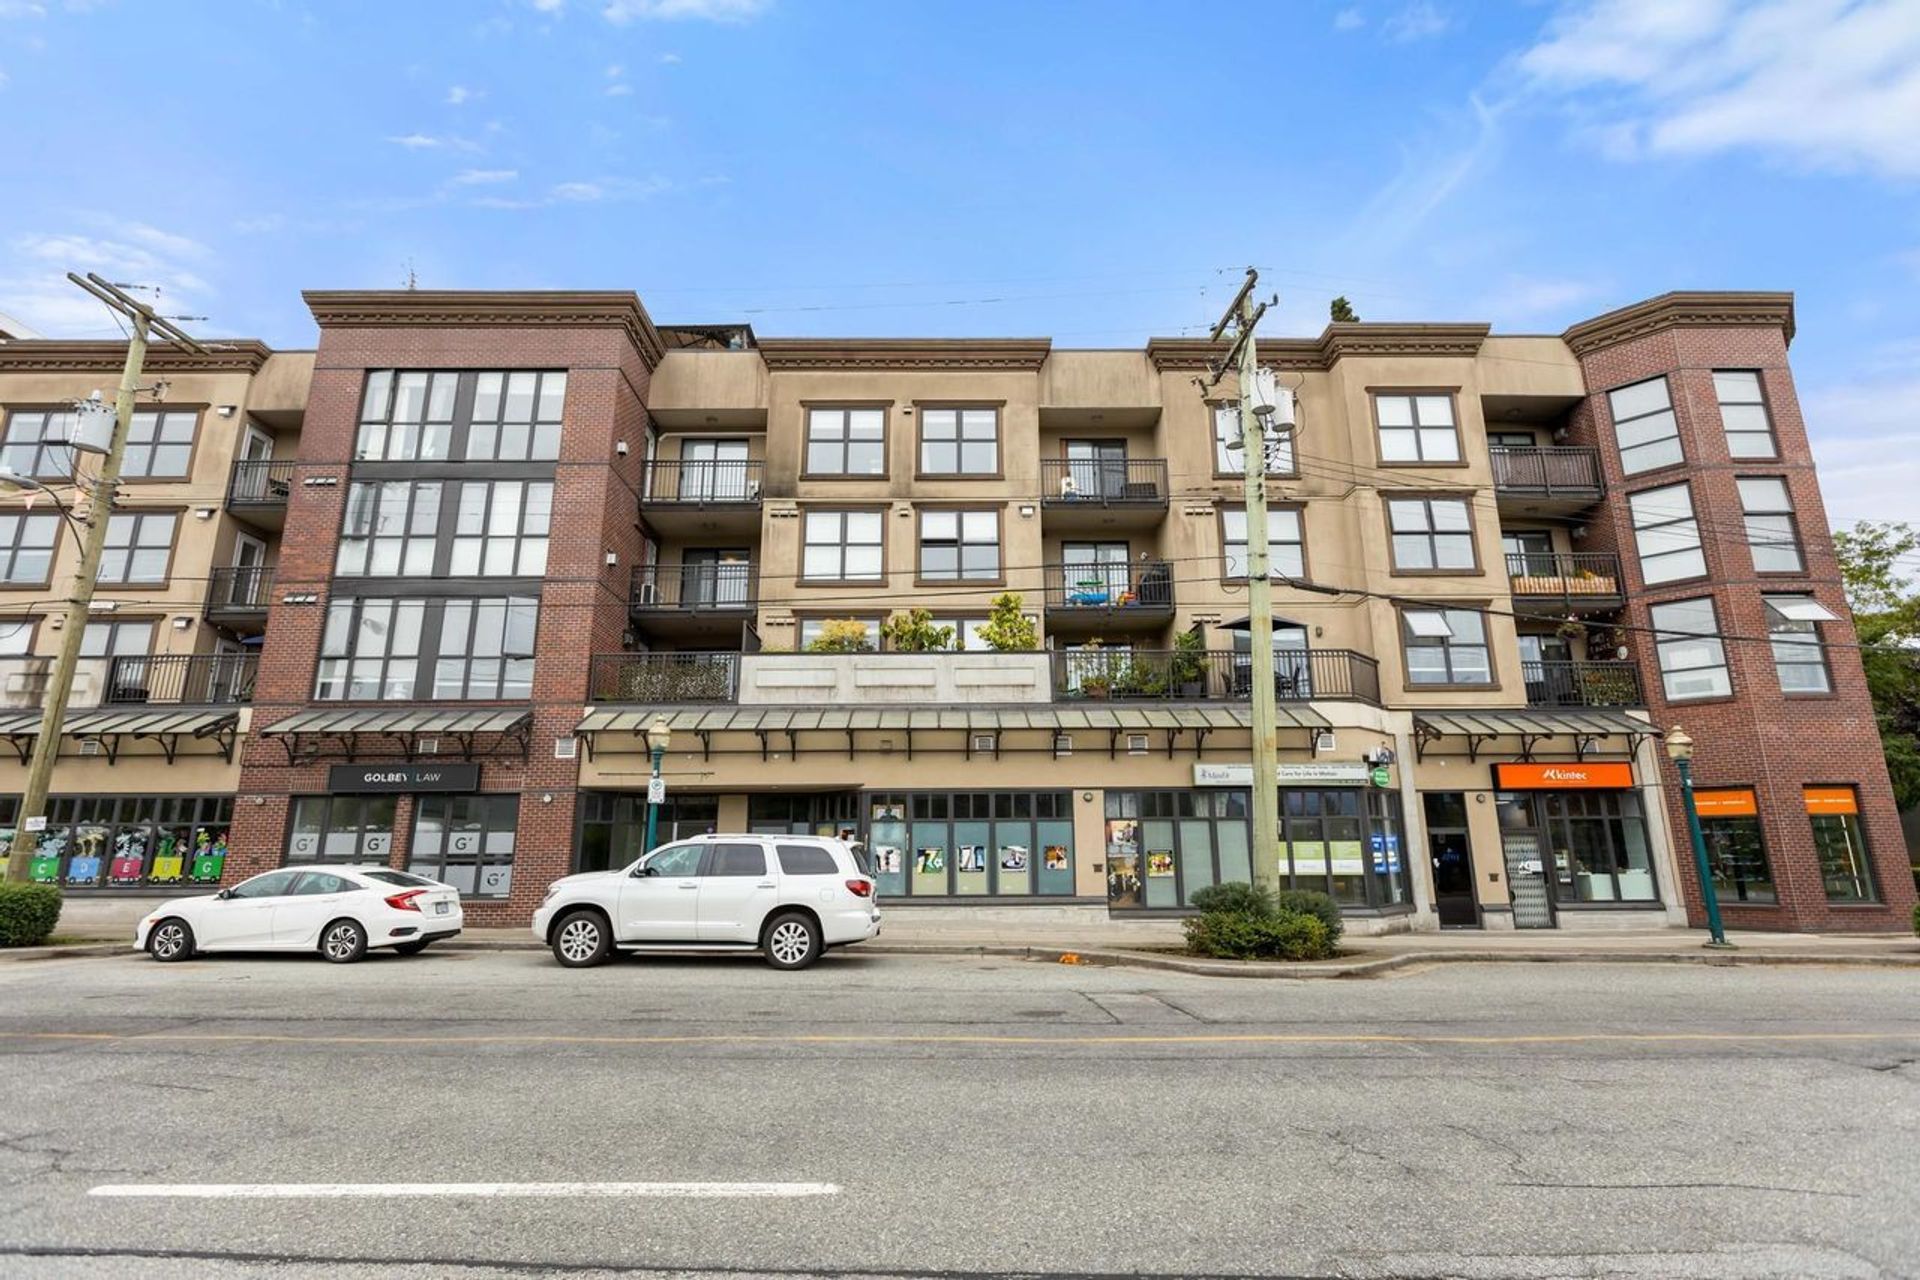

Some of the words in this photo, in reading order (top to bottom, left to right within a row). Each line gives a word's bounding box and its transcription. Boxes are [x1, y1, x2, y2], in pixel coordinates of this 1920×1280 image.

[415, 772, 441, 783] LAW
[37, 863, 48, 874] C
[122, 862, 130, 873] E
[202, 862, 213, 873] G
